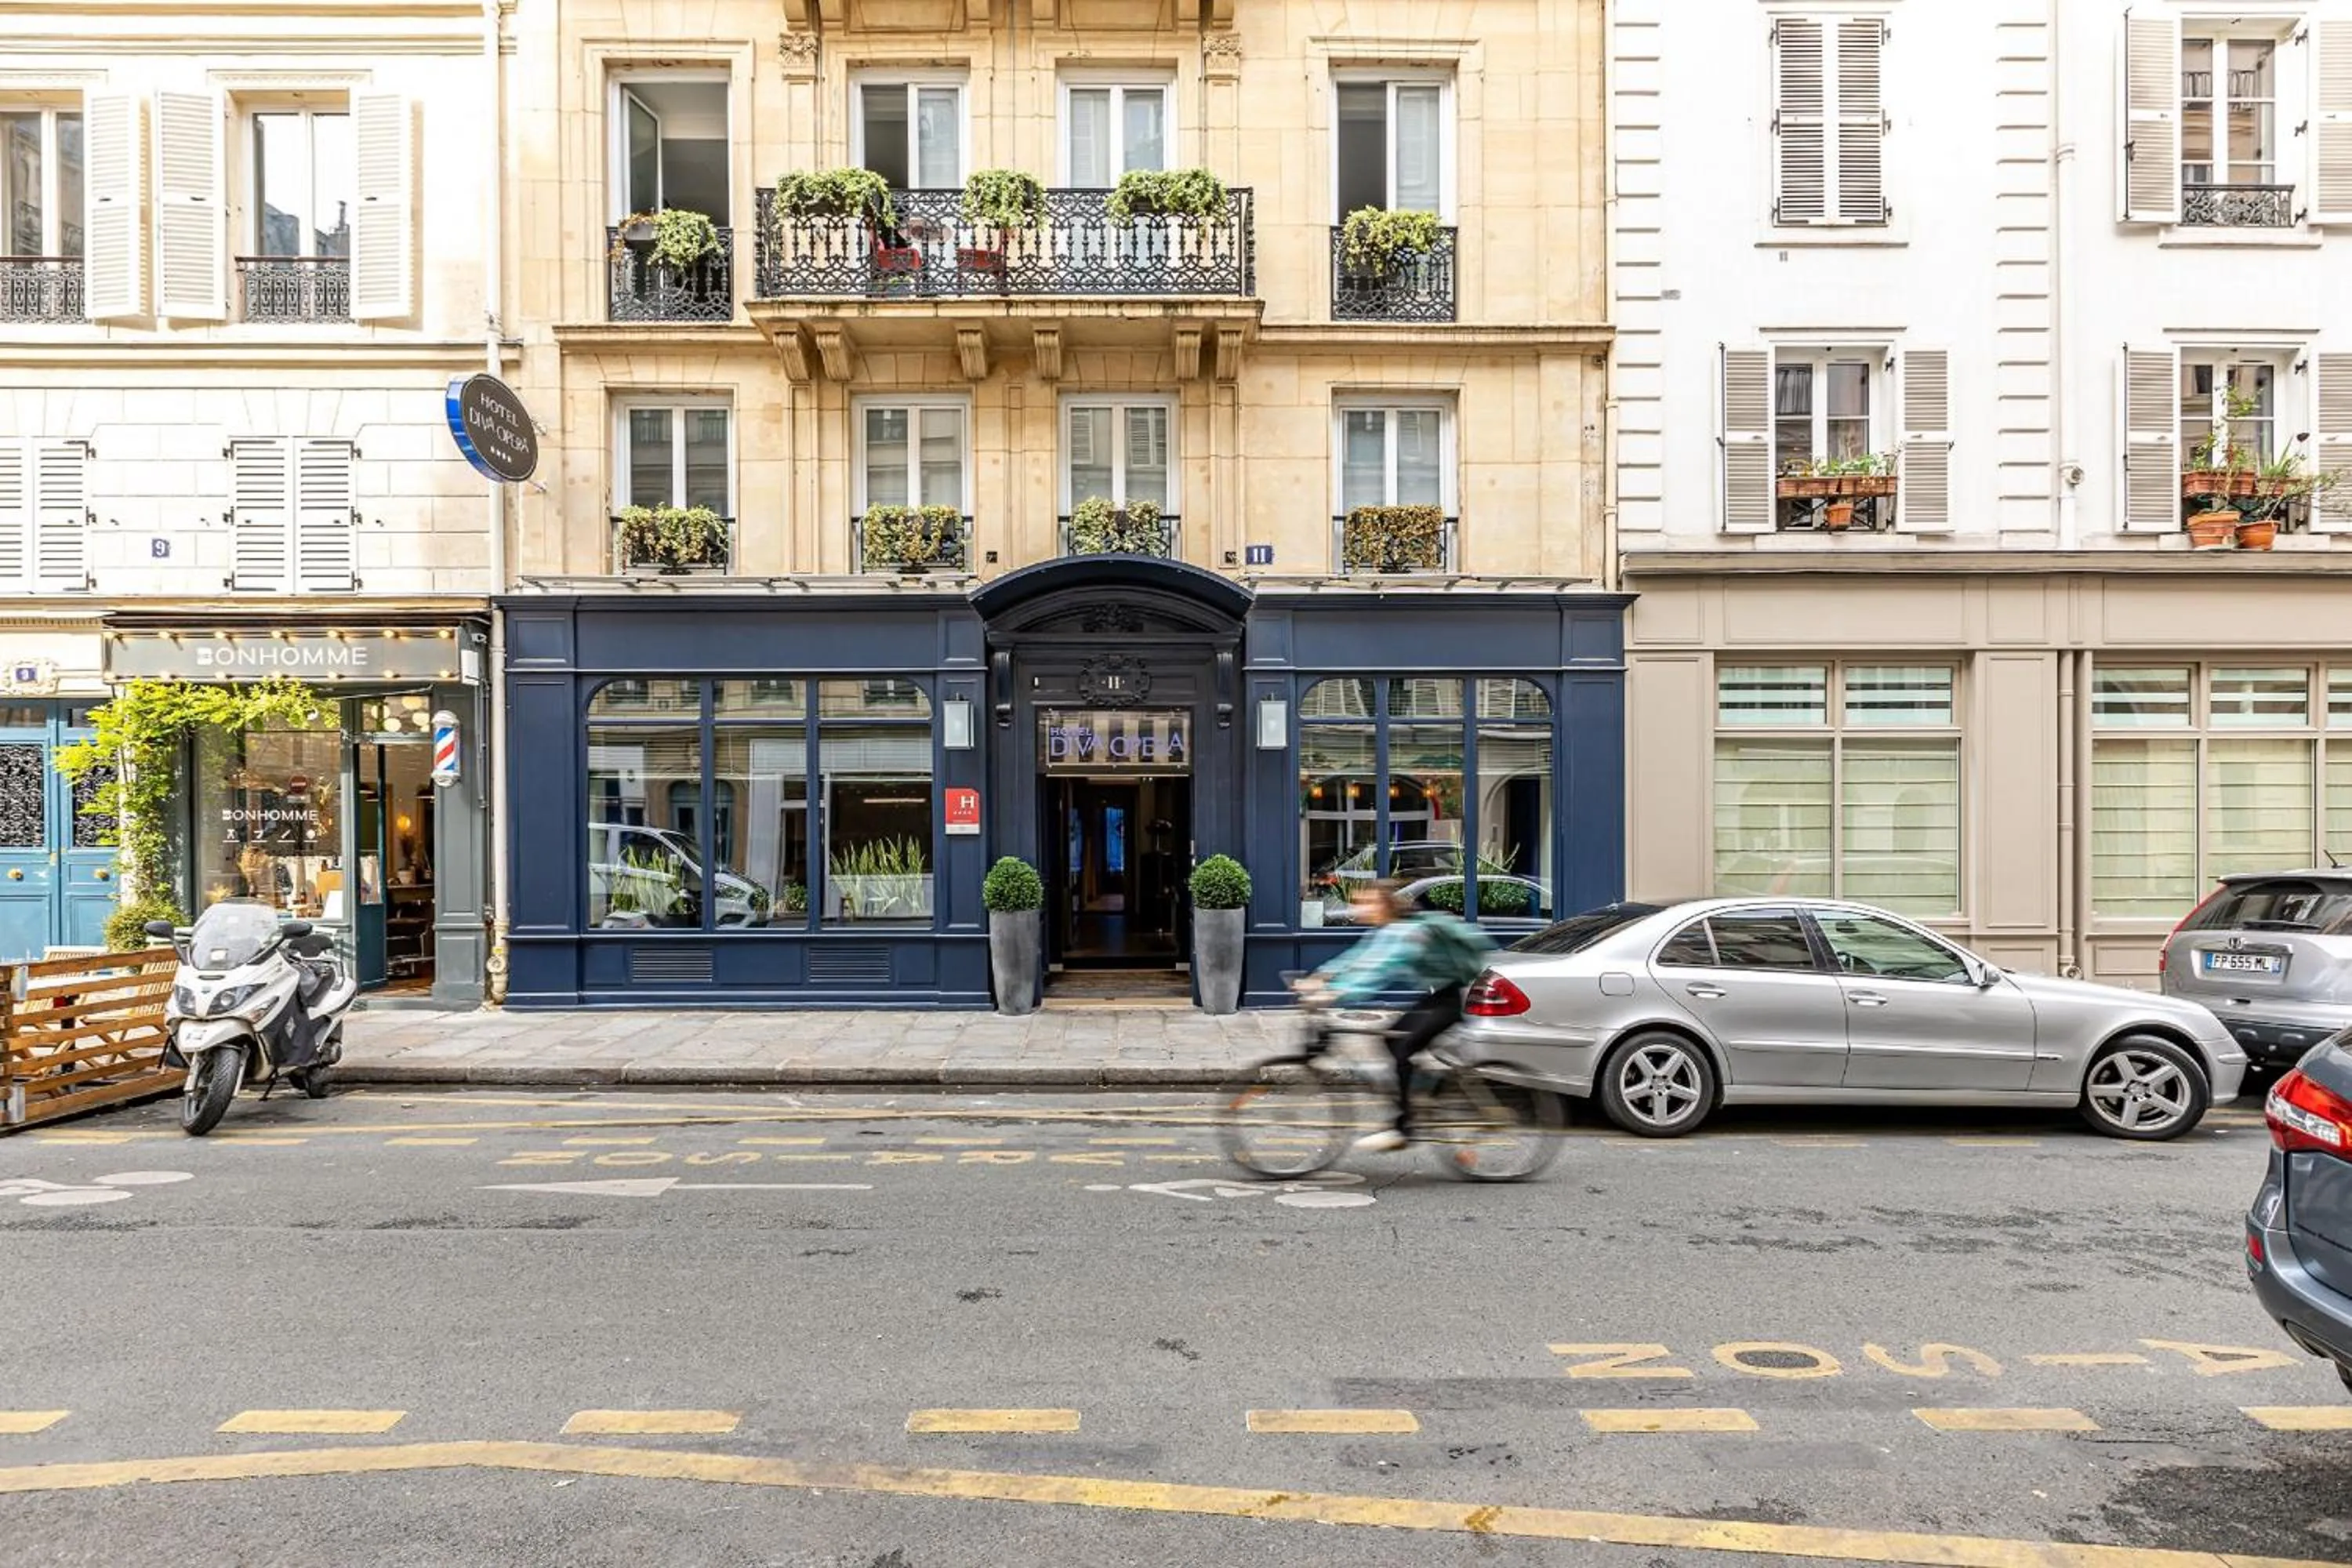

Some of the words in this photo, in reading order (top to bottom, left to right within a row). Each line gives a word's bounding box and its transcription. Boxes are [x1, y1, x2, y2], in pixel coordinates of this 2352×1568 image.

[481, 392, 519, 427] HOTEL
[470, 407, 495, 432] DIVA
[496, 426, 530, 453] OPERA
[155, 542, 165, 554] 9
[1254, 548, 1265, 561] 11
[196, 647, 368, 666] BONHOMME
[1050, 727, 1093, 737] HOTEL
[1051, 734, 1104, 757] DIVA
[960, 796, 975, 808] H
[222, 809, 319, 821] BONHOMME
